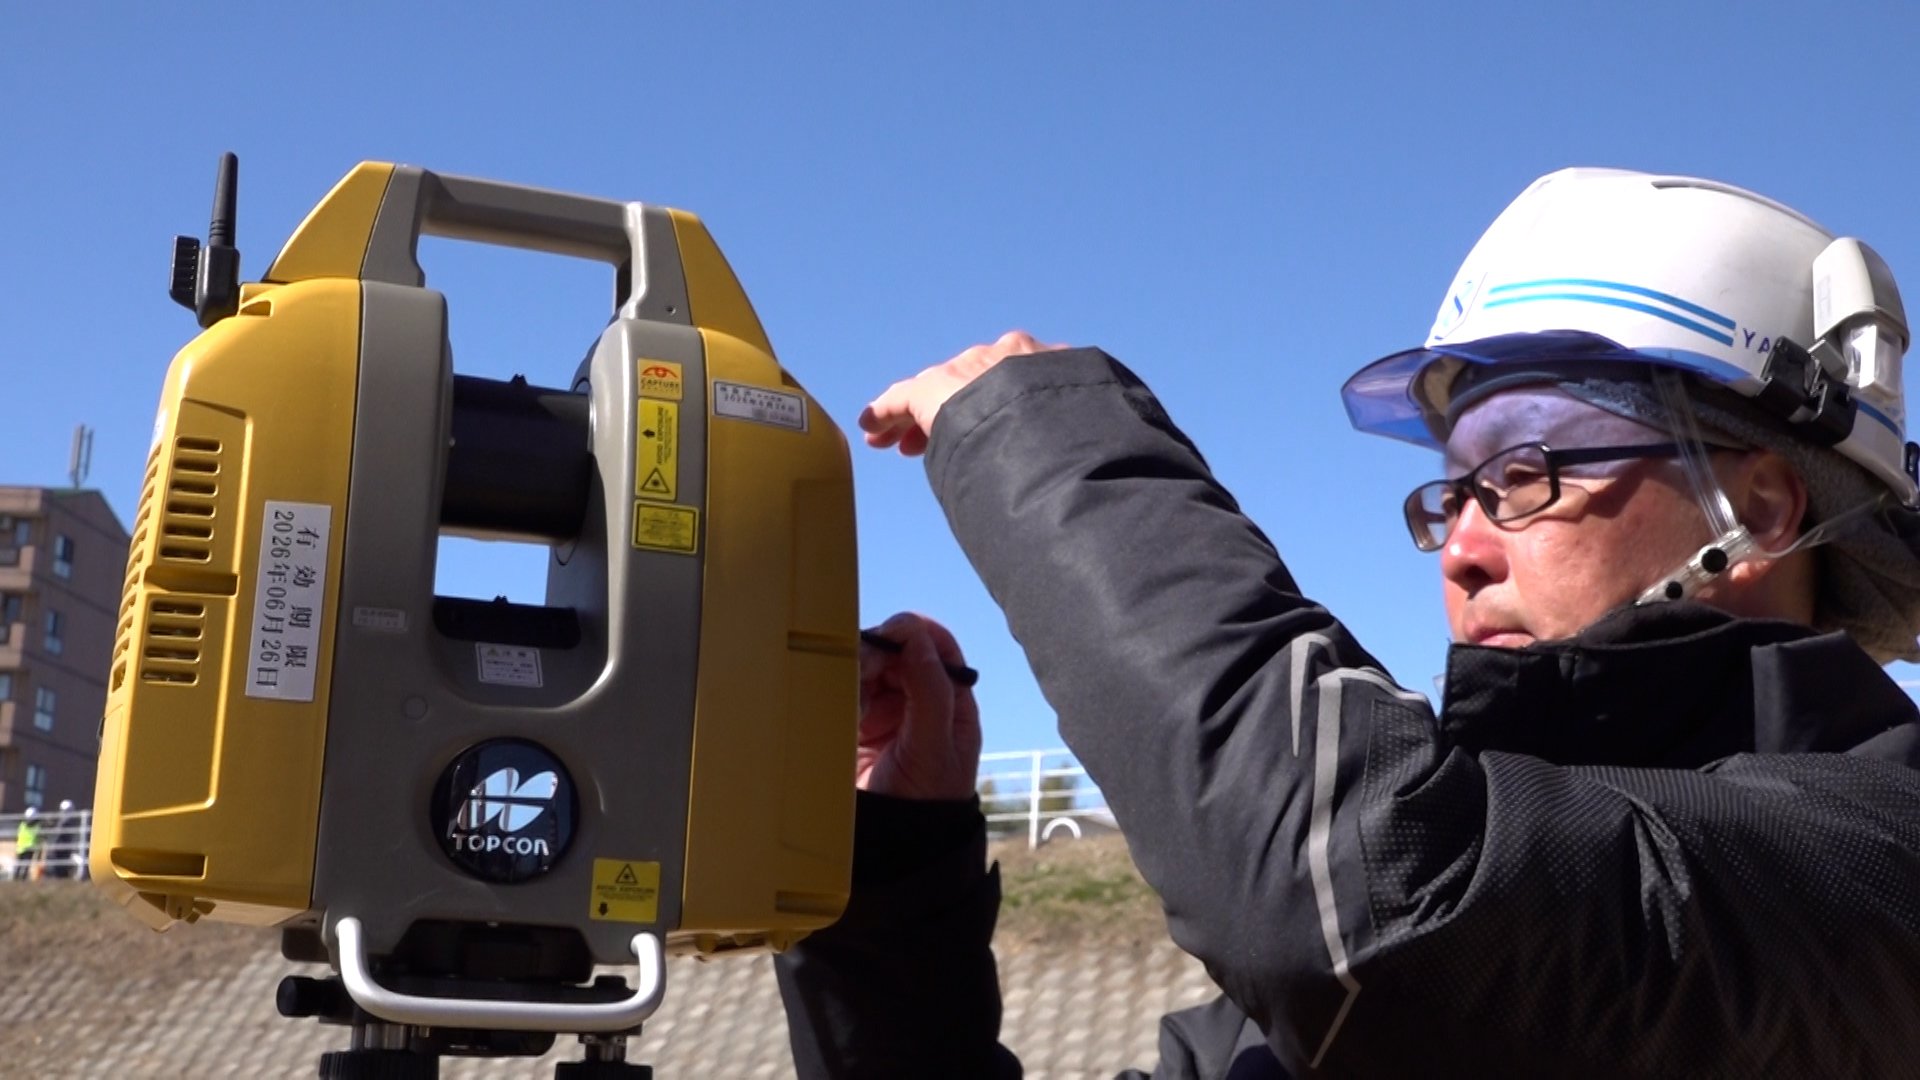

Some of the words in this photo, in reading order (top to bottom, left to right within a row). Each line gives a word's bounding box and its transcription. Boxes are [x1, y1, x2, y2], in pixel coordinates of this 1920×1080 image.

[256, 510, 295, 687] 2026年06月26日
[284, 527, 320, 668] 有効期限
[451, 833, 549, 856] TOPCON
